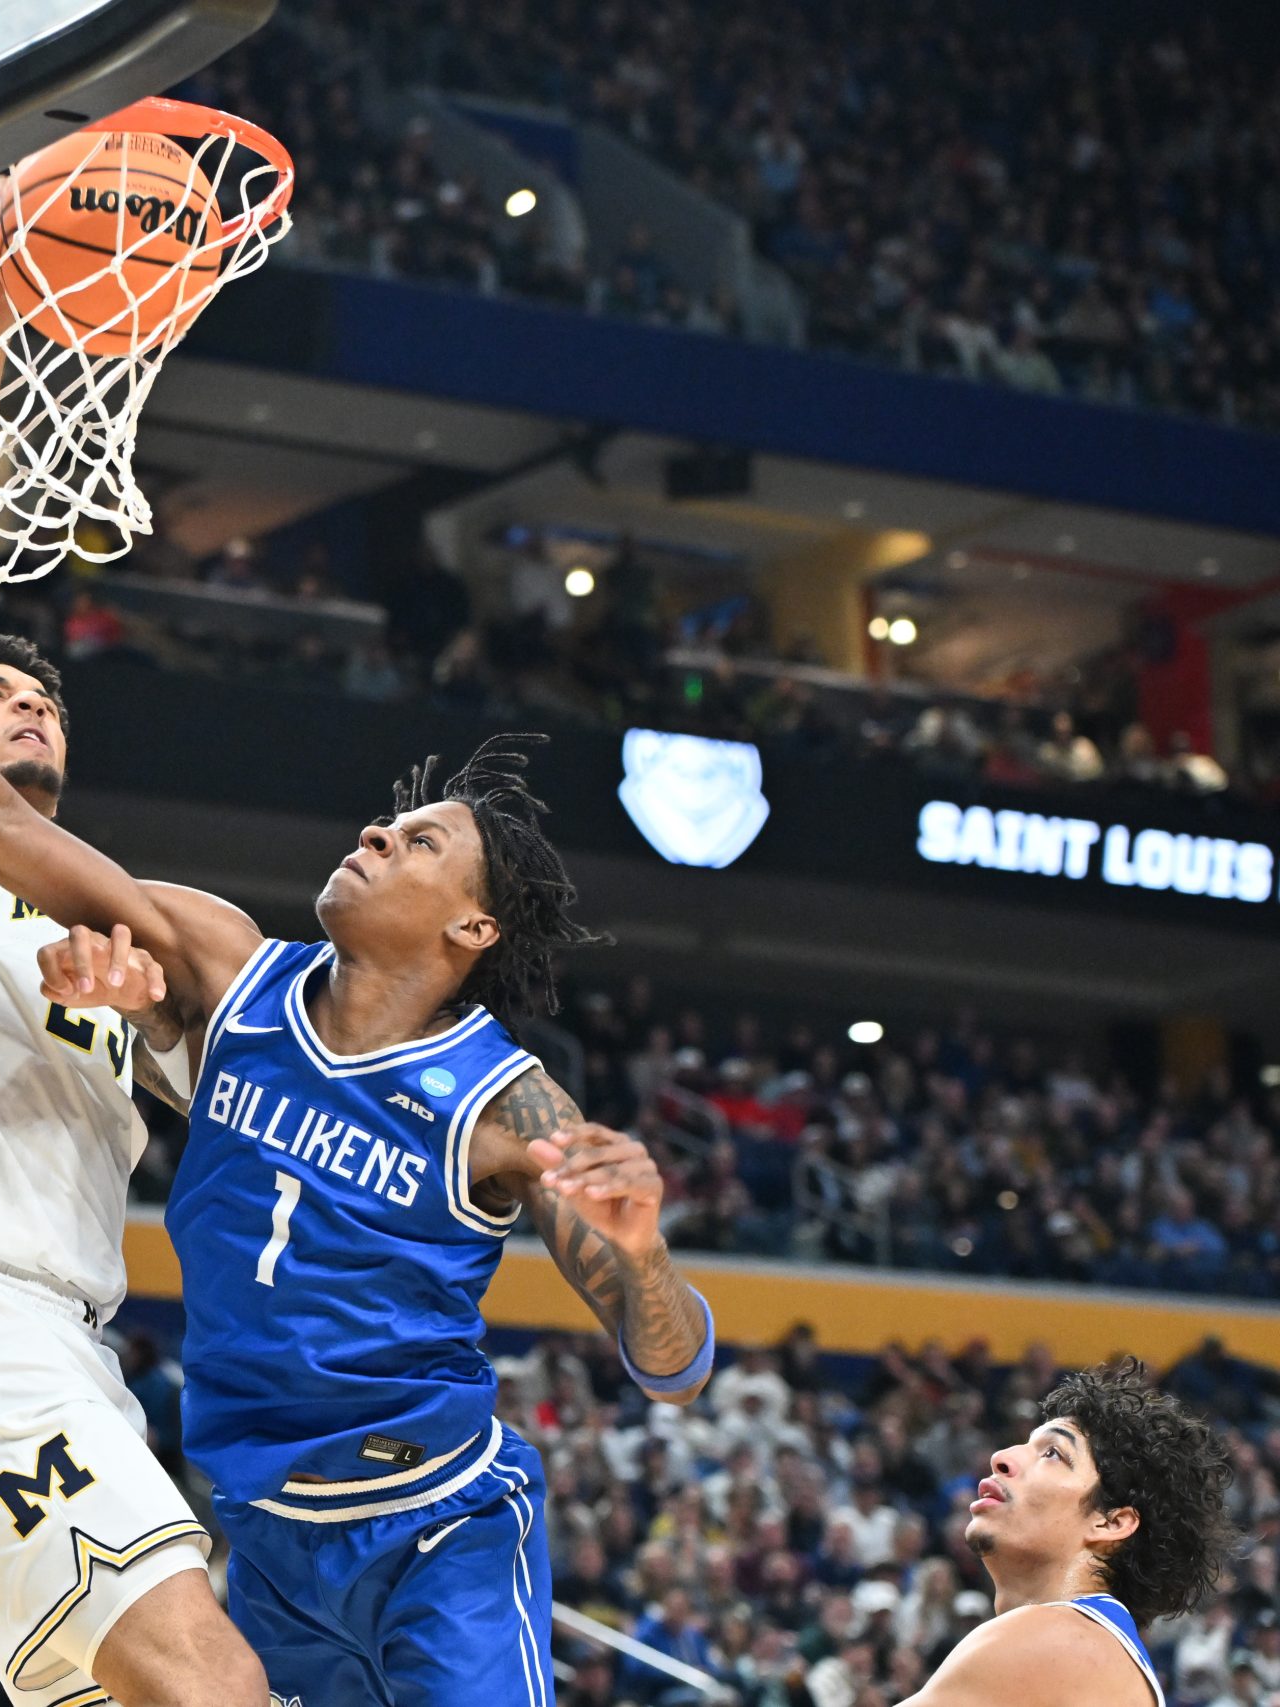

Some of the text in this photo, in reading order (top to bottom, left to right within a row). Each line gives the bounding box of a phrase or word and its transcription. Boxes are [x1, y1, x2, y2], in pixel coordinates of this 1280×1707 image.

[70, 186, 208, 250] Wilson
[917, 800, 1274, 903] SAINT LOUIS
[208, 1070, 428, 1207] BILLIKENS
[385, 1091, 435, 1122] A10
[254, 1170, 302, 1288] 1
[404, 1450, 411, 1461] L
